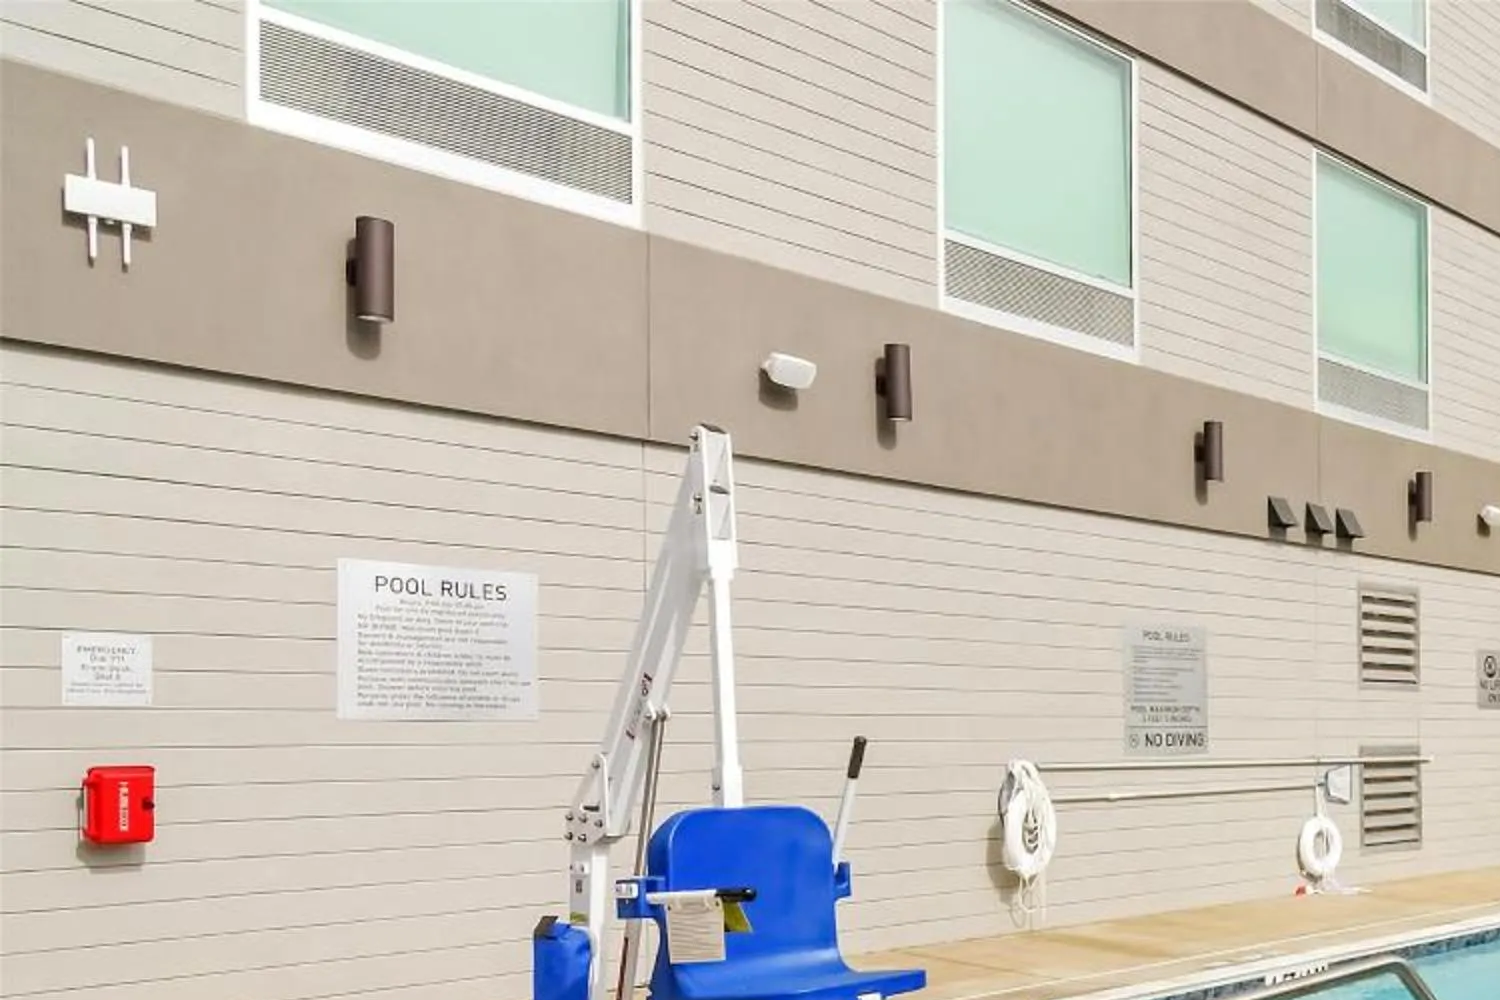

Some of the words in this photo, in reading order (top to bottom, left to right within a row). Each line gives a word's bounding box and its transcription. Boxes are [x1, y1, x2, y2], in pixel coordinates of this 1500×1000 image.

[374, 575, 433, 597] POOL
[440, 580, 508, 601] RULES
[1145, 733, 1163, 748] NO
[1165, 733, 1205, 748] DIVING
